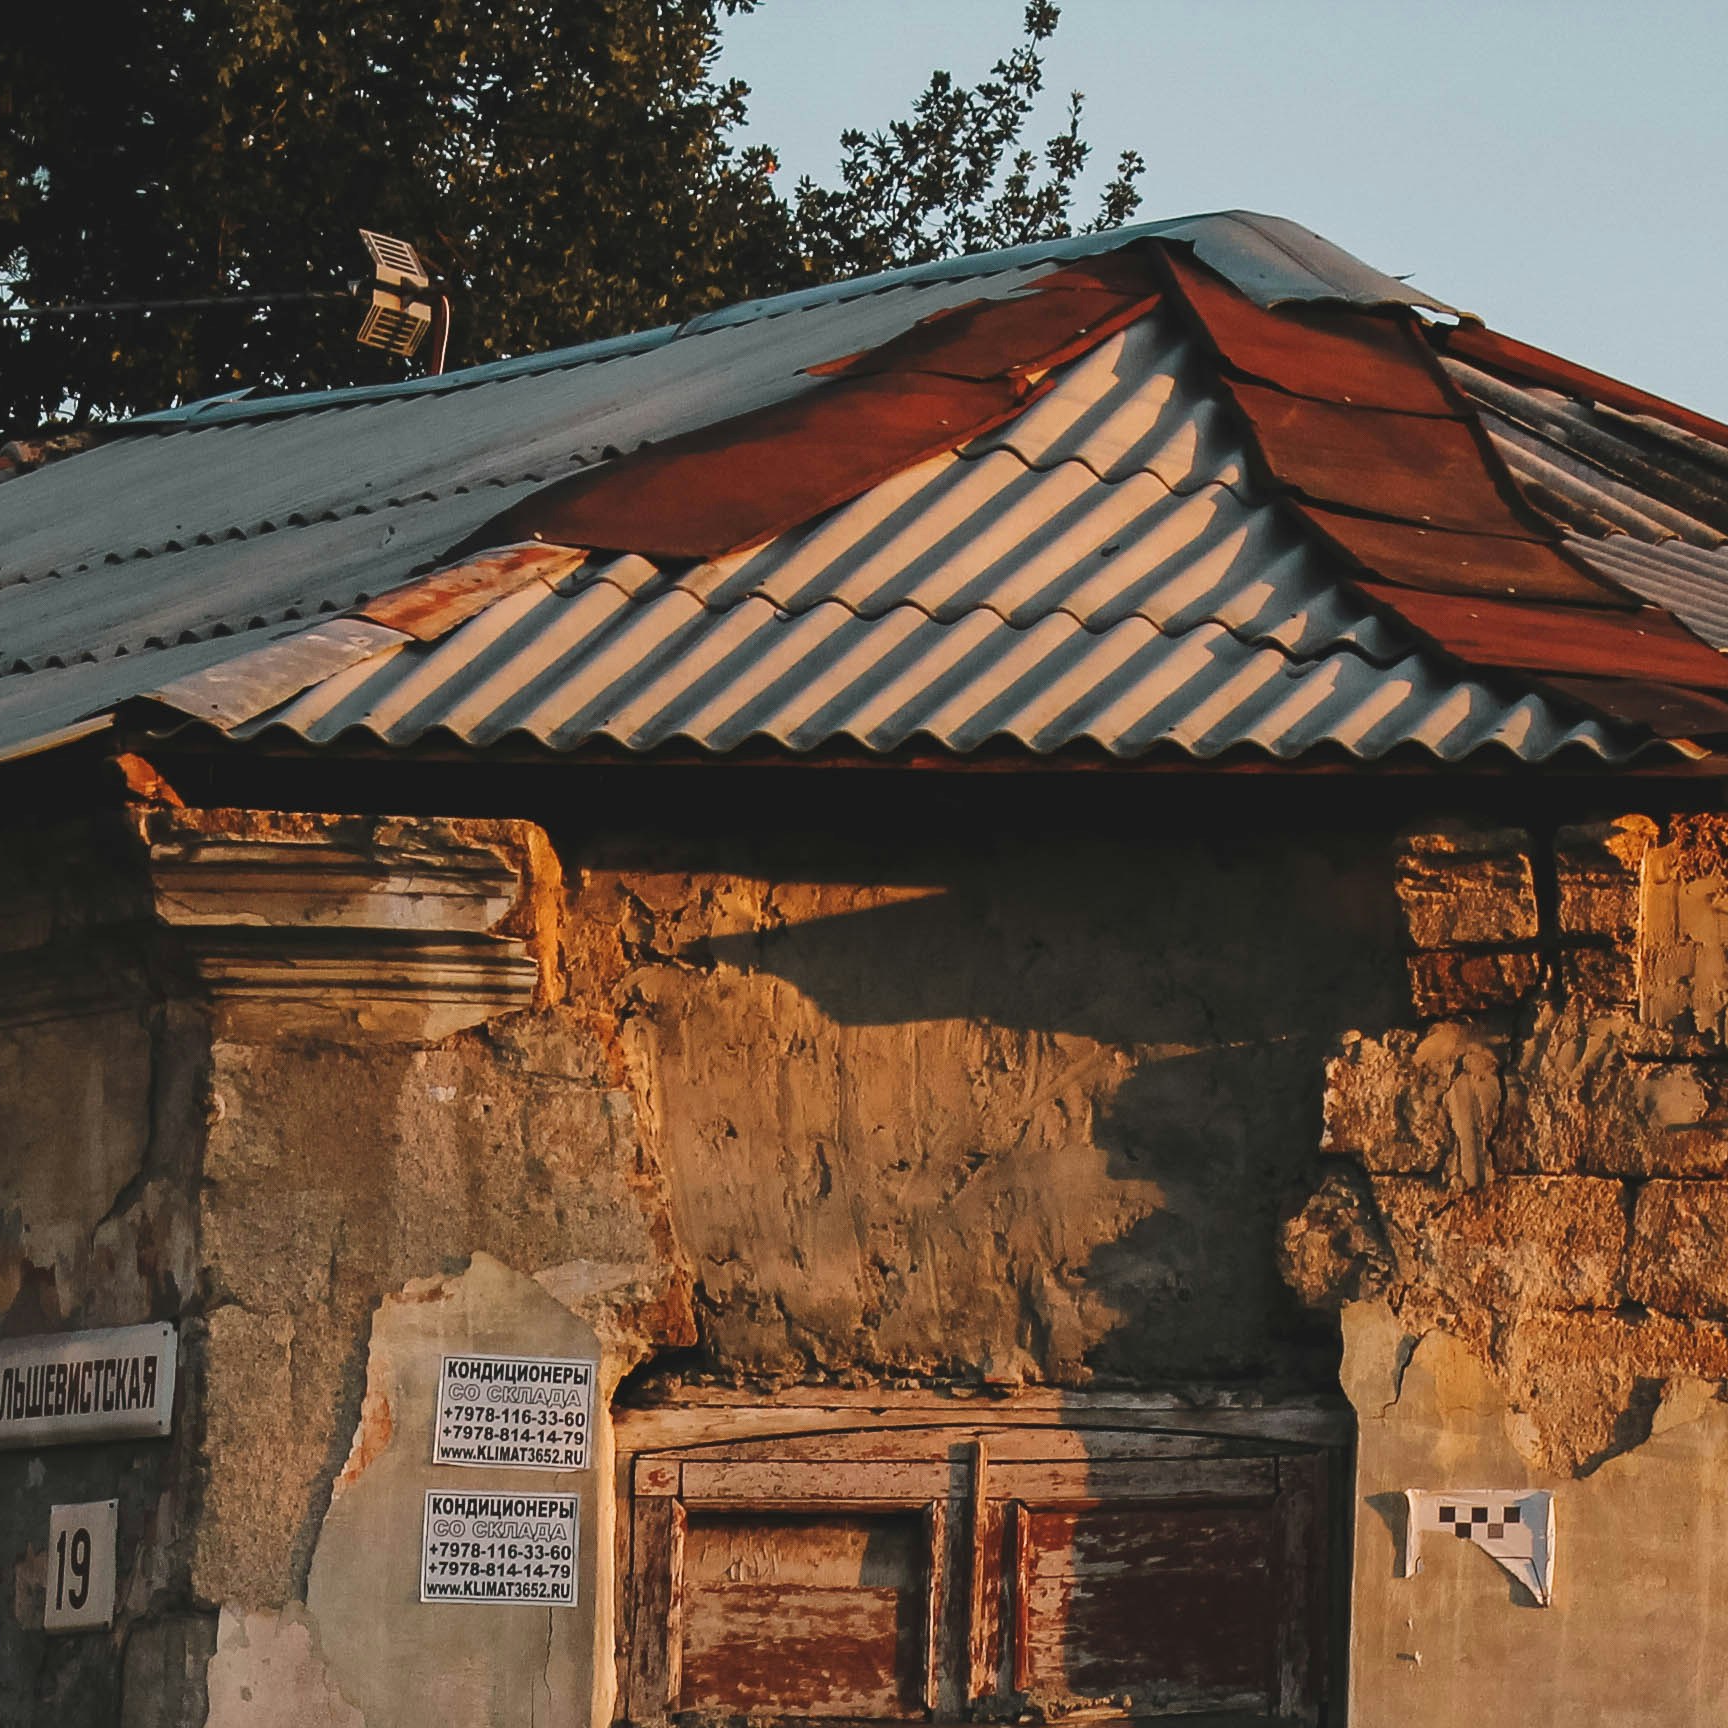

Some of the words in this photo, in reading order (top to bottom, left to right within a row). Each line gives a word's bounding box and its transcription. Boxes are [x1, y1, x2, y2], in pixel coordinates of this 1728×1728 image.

[447, 1361, 589, 1386] КОНДИЦИОНЕРЫ
[448, 1383, 481, 1400] СО
[486, 1385, 582, 1409] СКЛАДА
[443, 1405, 586, 1427] +7978-116-33-60
[442, 1425, 585, 1445] +7978-814-14-79
[440, 1445, 584, 1465] www.KLIMAT3652.RU
[432, 1497, 574, 1519] КОНДИЦИОНЕРЫ
[433, 1519, 466, 1537] СО
[472, 1520, 567, 1543] СКЛАДА
[429, 1542, 572, 1561] +7978-116-33-60
[55, 1528, 91, 1611] 19
[428, 1561, 571, 1579] +7978-814-14-79
[426, 1580, 570, 1599] www.KLIMAT3652.RU
